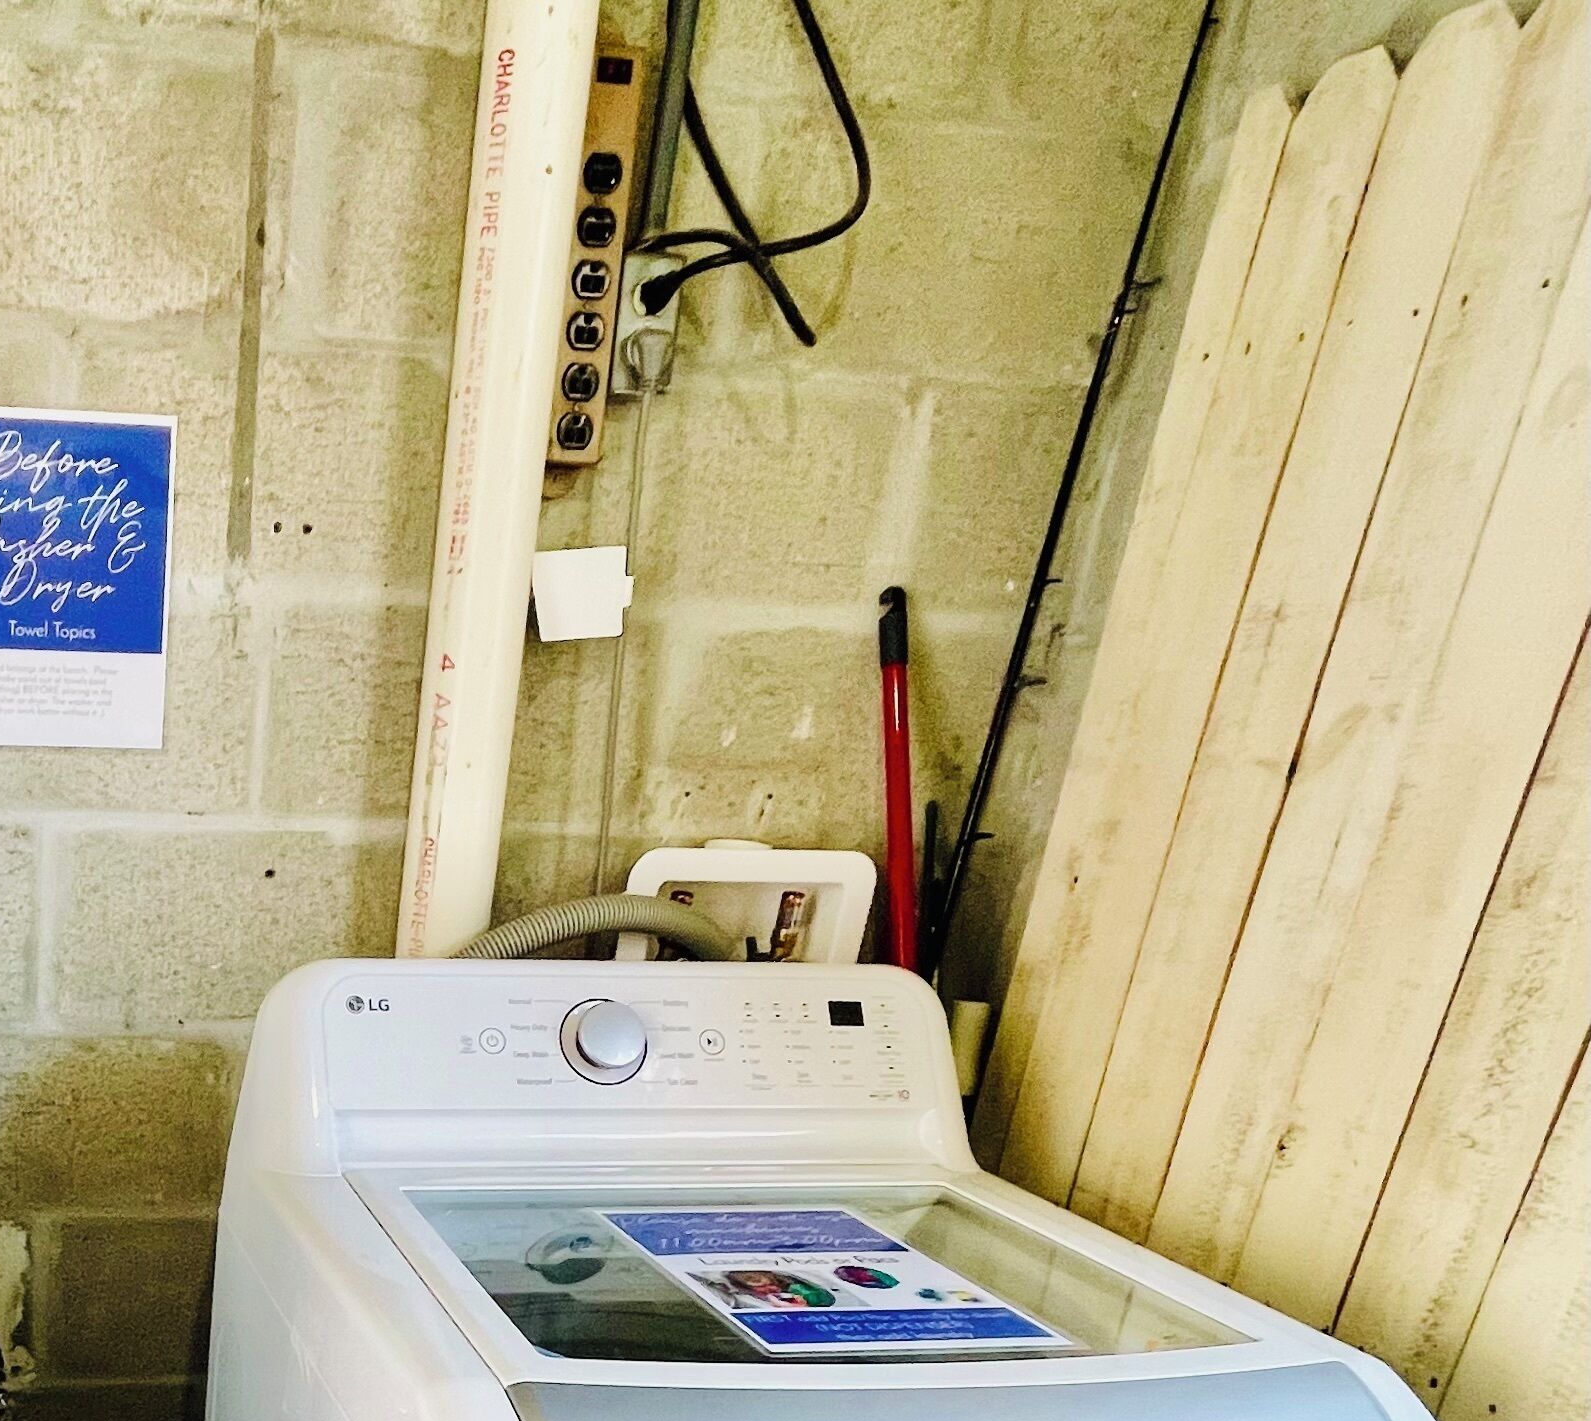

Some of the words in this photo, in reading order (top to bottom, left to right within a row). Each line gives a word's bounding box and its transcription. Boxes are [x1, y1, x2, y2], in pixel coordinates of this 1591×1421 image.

[485, 48, 515, 179] CHARLOTTE
[480, 190, 502, 238] PIPE
[79, 478, 146, 541] the
[107, 520, 146, 573] &
[8, 620, 48, 638] Towel
[54, 620, 96, 641] Topics
[441, 653, 455, 672] 4
[369, 999, 390, 1012] LG
[697, 1257, 779, 1266] Laundry
